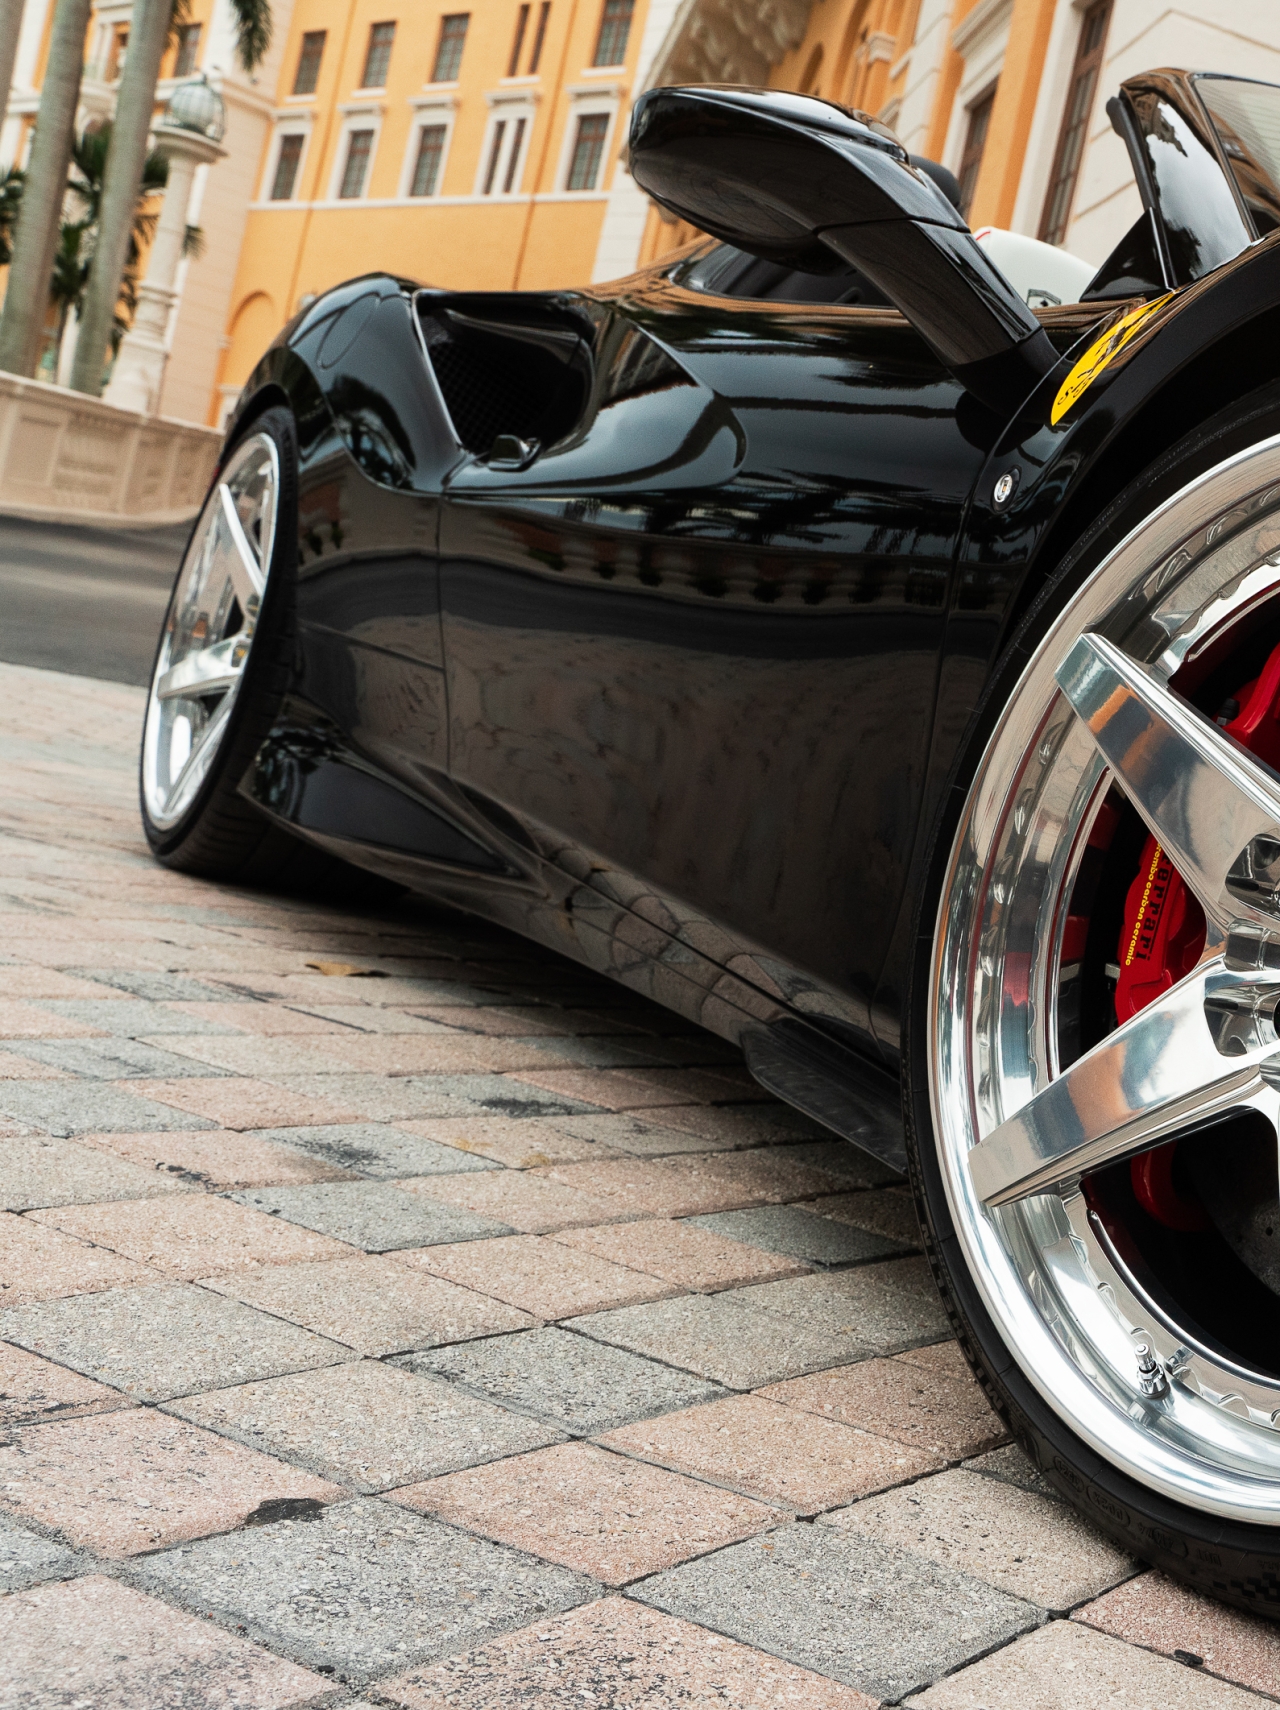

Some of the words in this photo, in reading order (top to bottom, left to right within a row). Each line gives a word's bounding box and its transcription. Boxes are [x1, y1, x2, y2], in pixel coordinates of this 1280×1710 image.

[1137, 881, 1152, 920] carbon
[1125, 921, 1141, 966] ceramic
[917, 1220, 1008, 1412] MICHELIN
